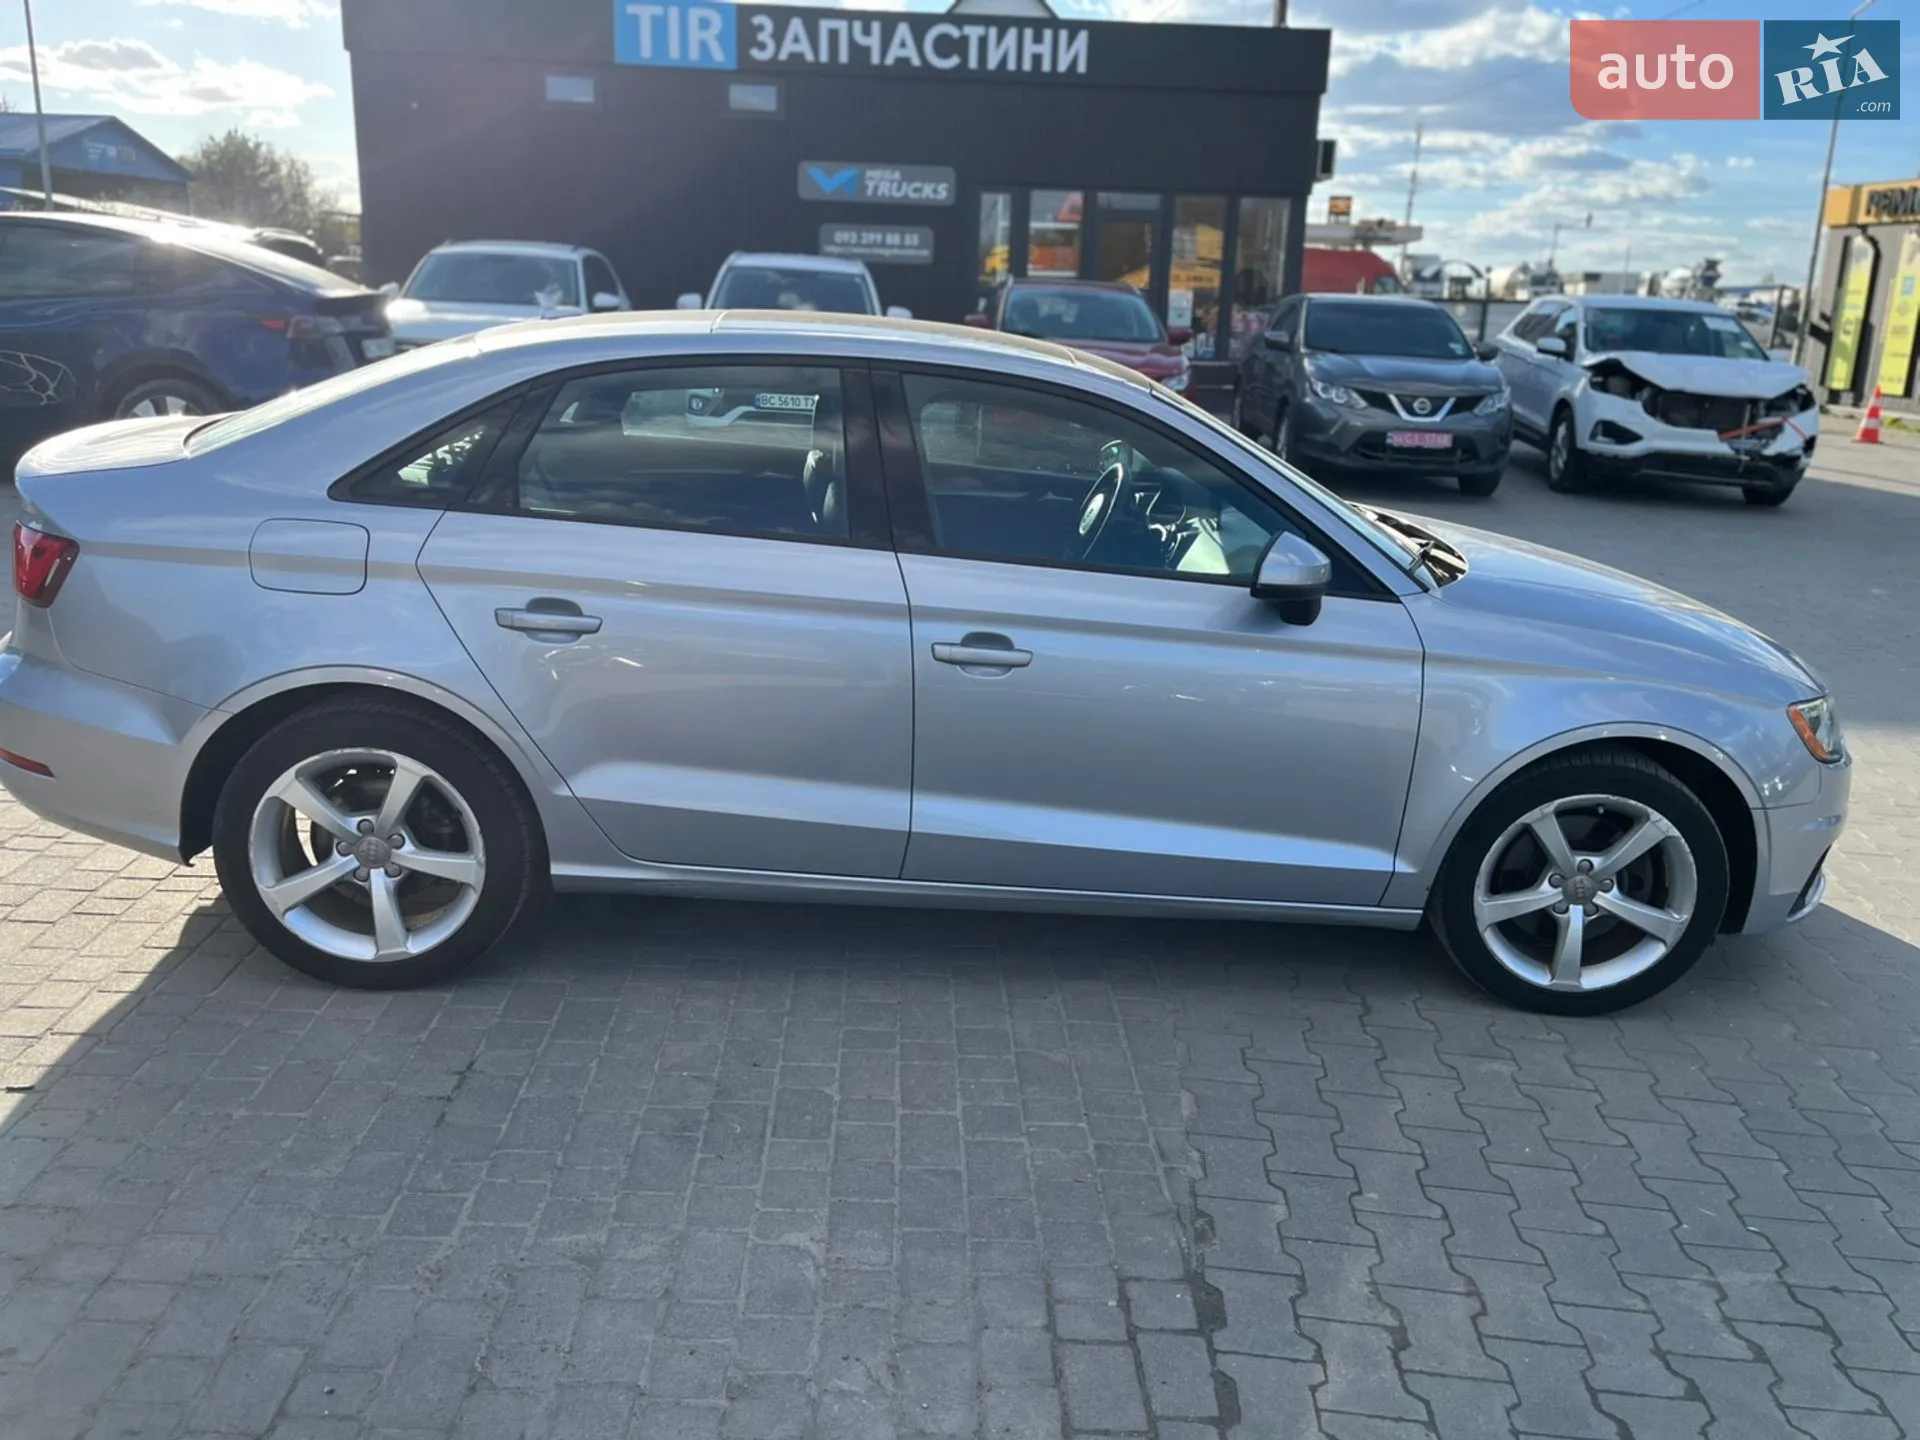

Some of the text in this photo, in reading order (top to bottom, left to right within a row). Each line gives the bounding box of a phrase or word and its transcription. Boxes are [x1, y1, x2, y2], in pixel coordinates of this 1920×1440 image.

[626, 4, 725, 62] TIR
[749, 14, 1088, 74] ЗАПЧАСТИНИ
[864, 180, 949, 199] TRUCKS
[761, 395, 776, 406] BC
[778, 396, 801, 407] 5610
